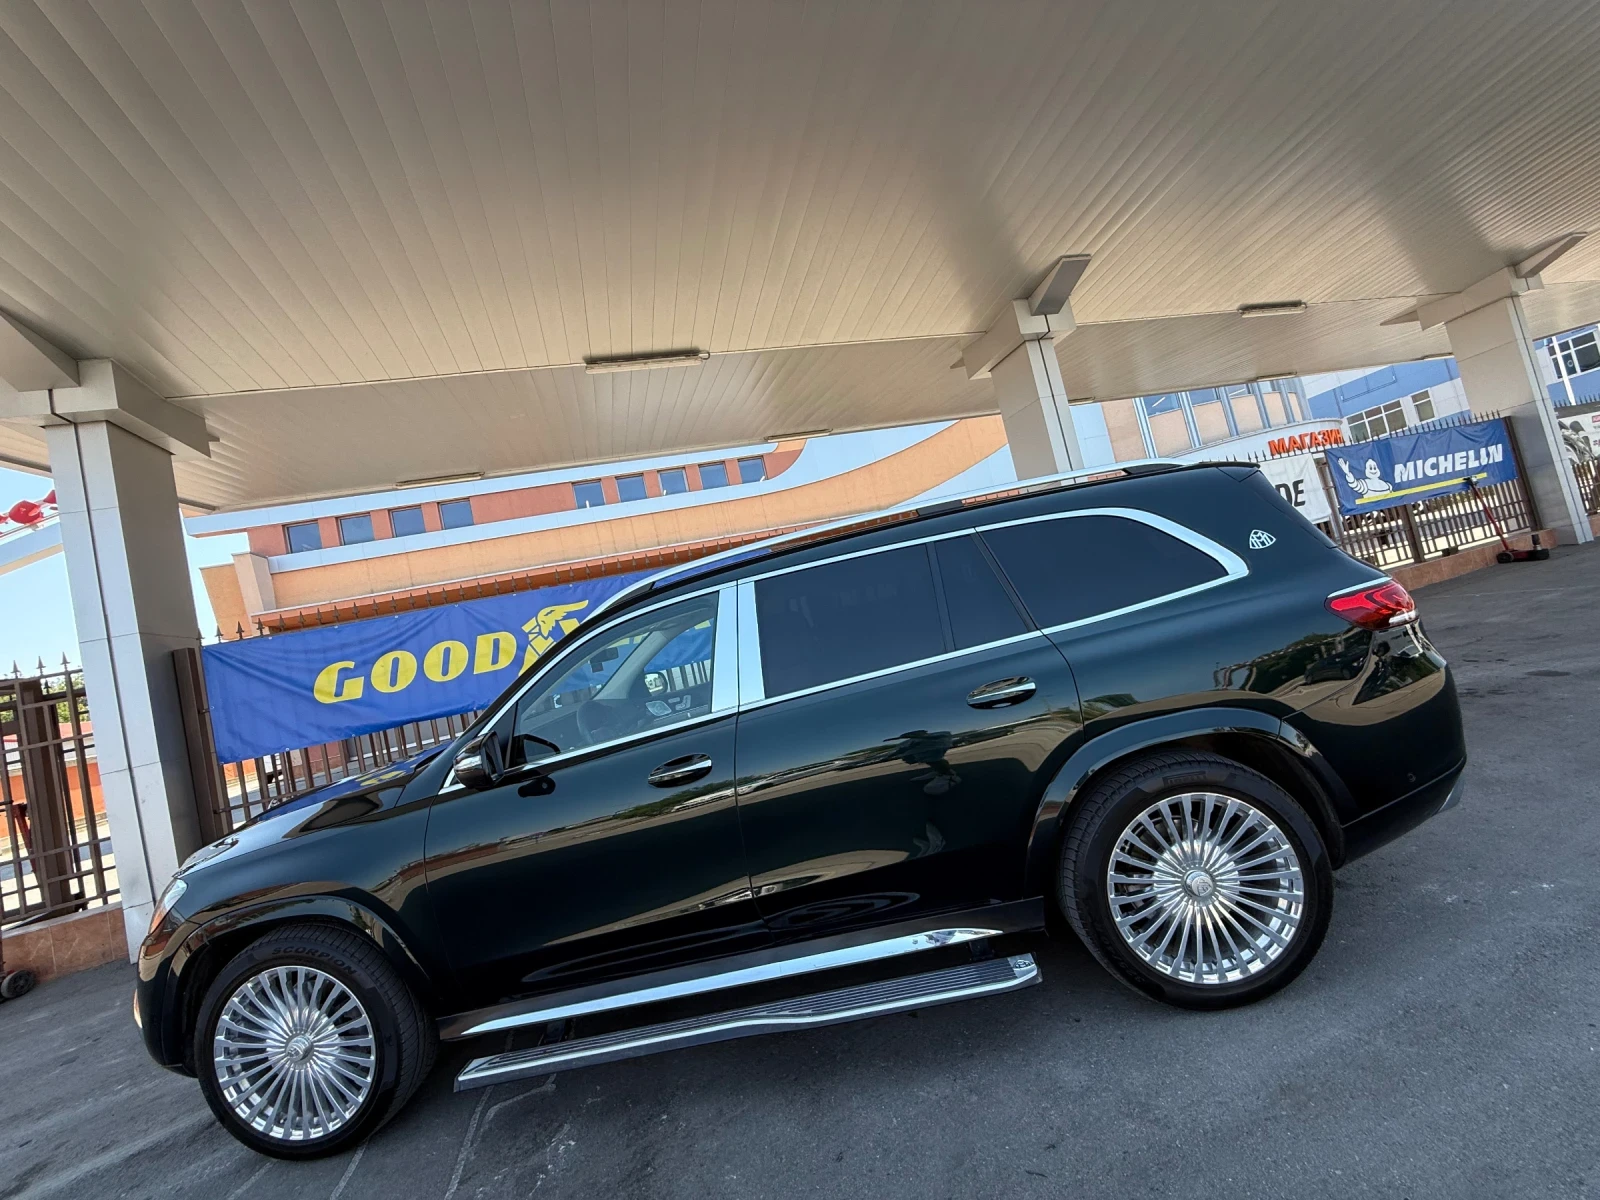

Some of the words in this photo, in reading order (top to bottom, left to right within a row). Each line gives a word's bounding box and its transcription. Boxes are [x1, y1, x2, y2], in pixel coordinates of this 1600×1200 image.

[1268, 428, 1344, 457] МАГАЗИН
[1394, 443, 1503, 483] MICHELIN
[313, 618, 582, 704] GOOD
[271, 945, 358, 975] SCORPION
